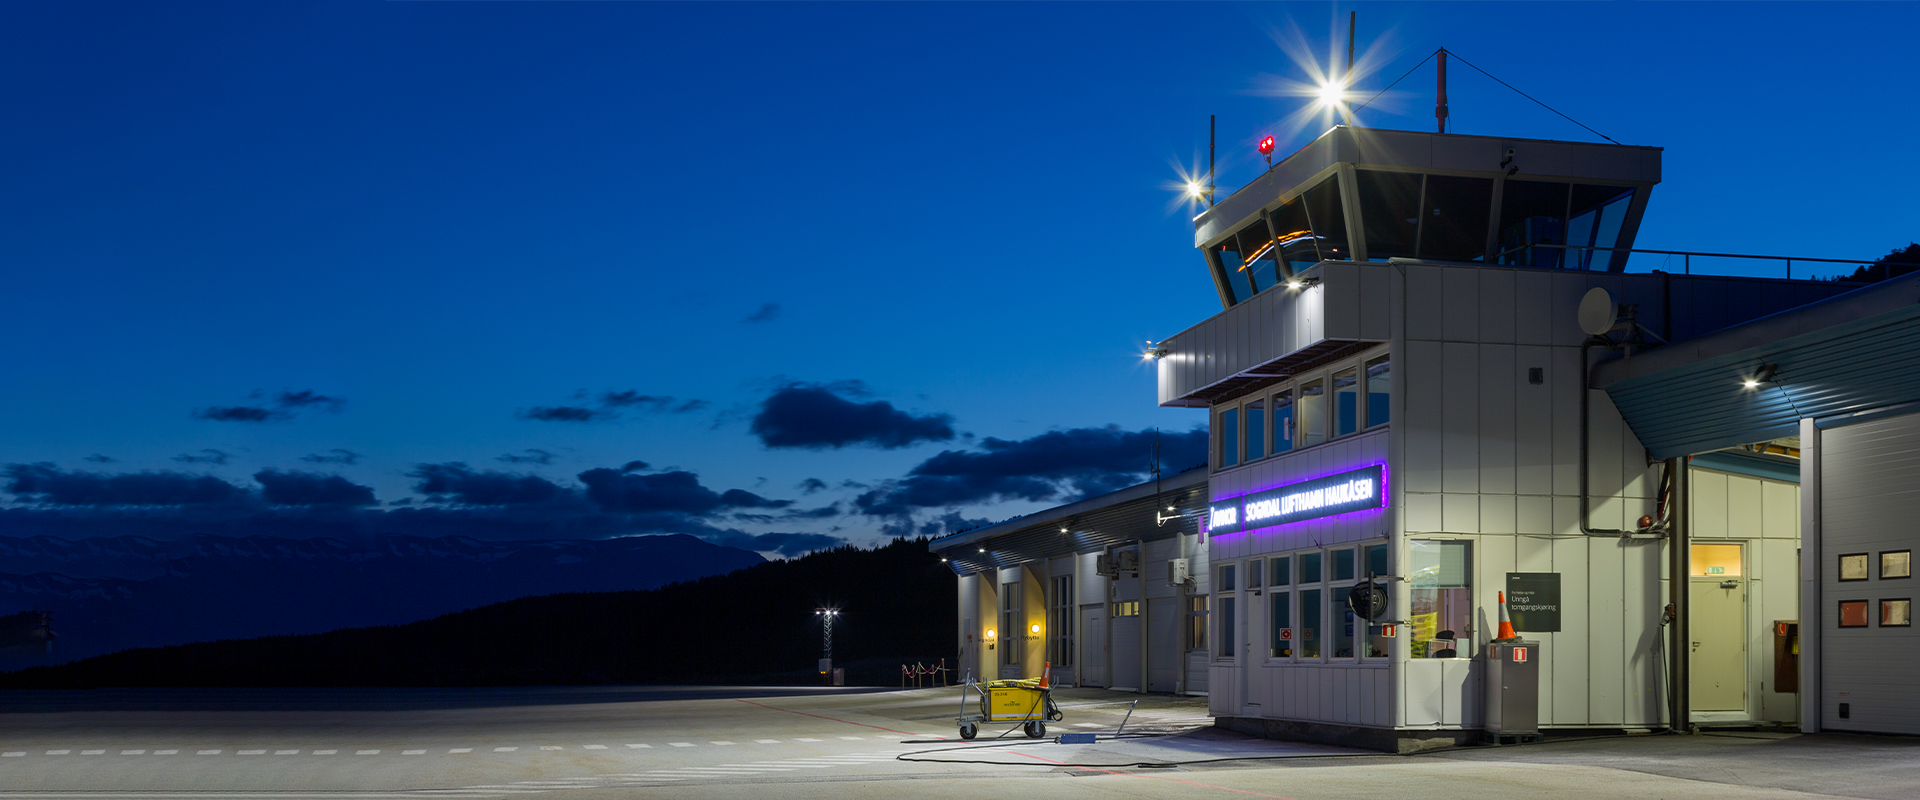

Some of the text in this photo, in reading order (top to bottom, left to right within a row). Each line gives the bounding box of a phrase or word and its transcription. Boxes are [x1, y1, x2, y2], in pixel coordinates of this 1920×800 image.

[1245, 498, 1281, 521] SOGNDAL
[1281, 489, 1324, 514] LUFTHAMN
[1325, 478, 1373, 506] HAUKÅSEN
[1511, 595, 1530, 604] Unngå
[1511, 604, 1557, 612] tomgangskjøring
